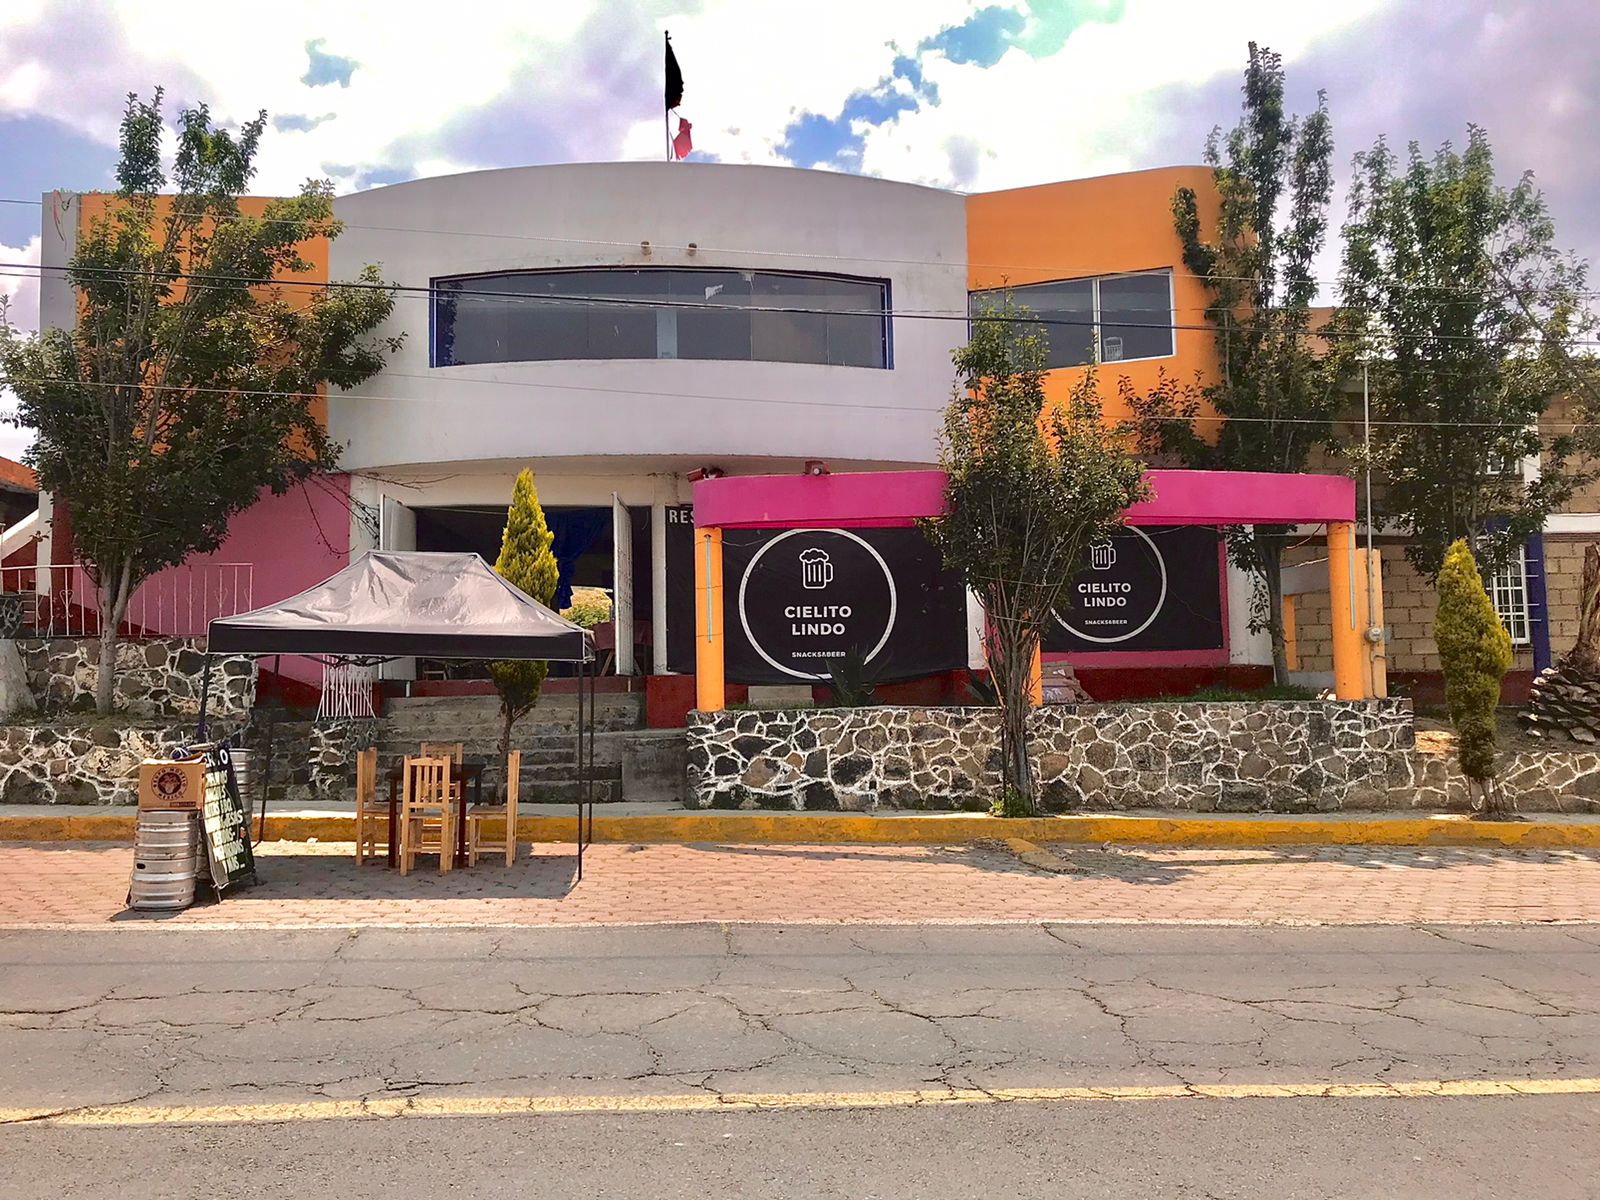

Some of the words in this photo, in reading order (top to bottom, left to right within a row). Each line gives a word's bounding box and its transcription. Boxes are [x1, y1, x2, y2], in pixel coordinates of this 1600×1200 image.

[1077, 583, 1131, 593] CIELITO
[1084, 597, 1127, 607] LINDO
[784, 606, 852, 619] CIELITO
[792, 623, 846, 636] LINDO
